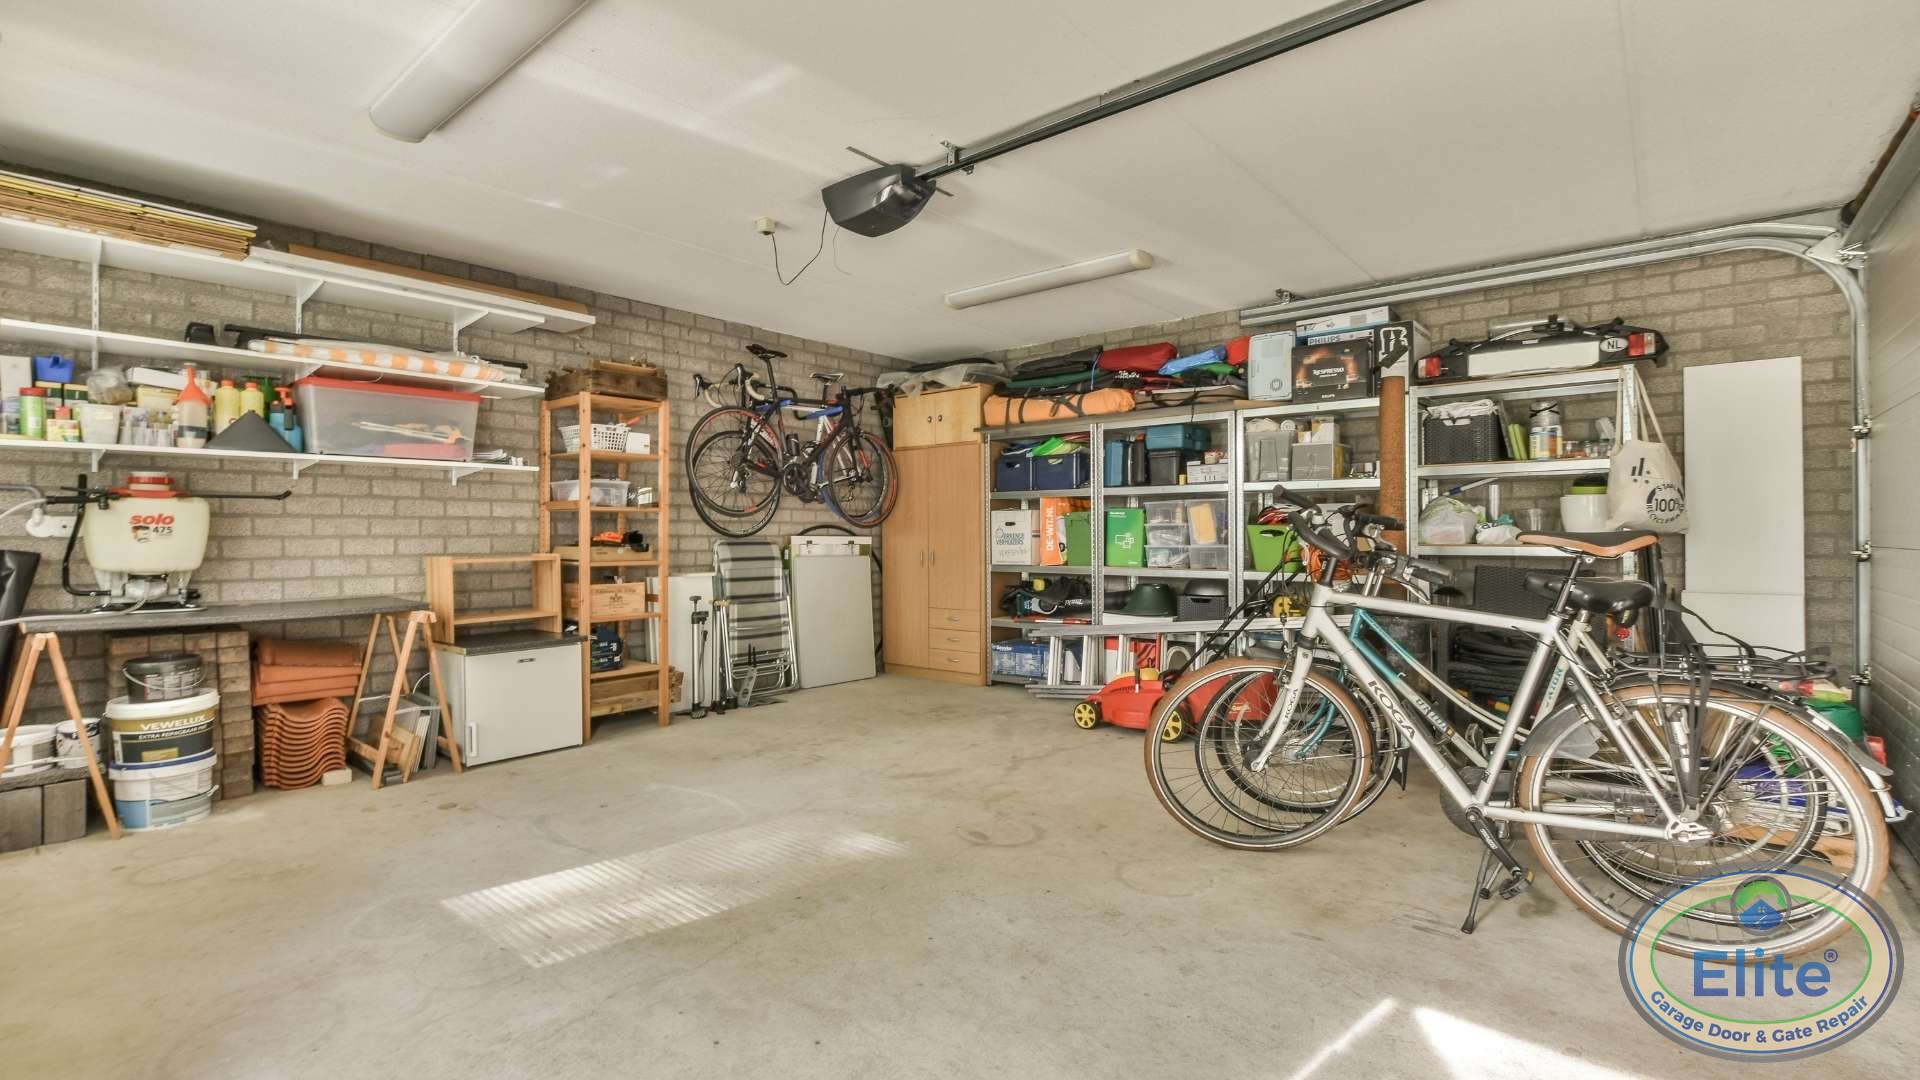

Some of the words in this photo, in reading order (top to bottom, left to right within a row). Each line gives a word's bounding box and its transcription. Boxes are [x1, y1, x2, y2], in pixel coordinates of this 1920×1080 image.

[1309, 335, 1340, 345] PHILIPS
[1607, 340, 1624, 350] NL
[1312, 367, 1345, 376] NESPRESSO
[128, 513, 175, 525] solo
[152, 526, 174, 534] 475
[1368, 680, 1416, 739] KOGA
[140, 714, 207, 731] VEWELUX
